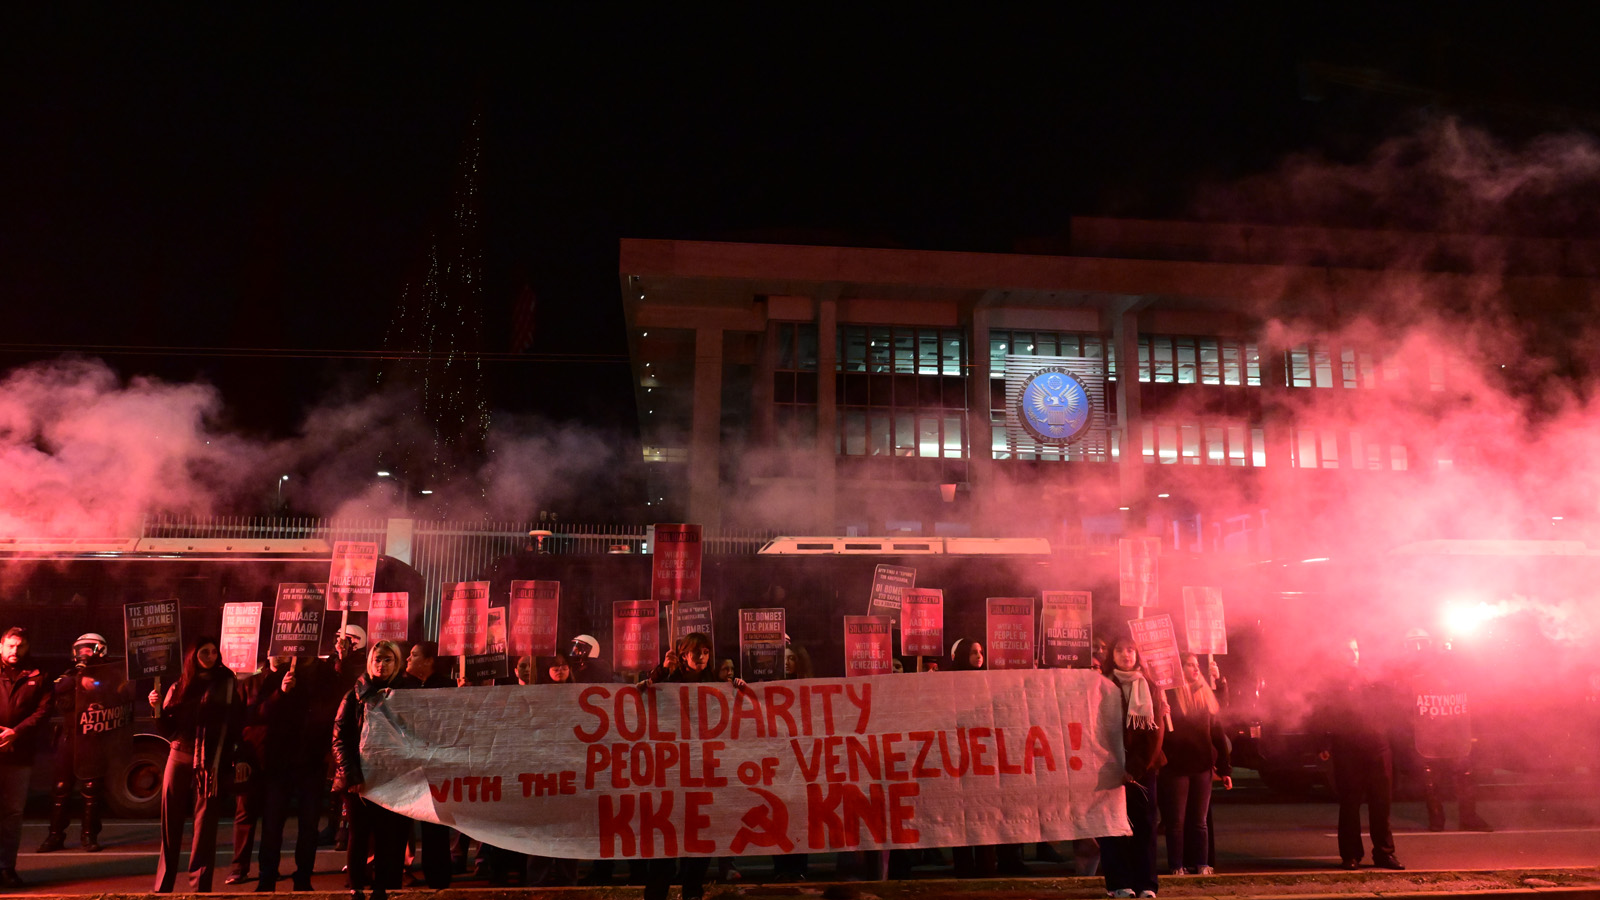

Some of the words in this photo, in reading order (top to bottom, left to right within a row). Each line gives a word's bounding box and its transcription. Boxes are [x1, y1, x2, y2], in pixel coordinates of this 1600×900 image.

[1017, 378, 1031, 407] UNITED
[1033, 366, 1060, 378] STATES
[1064, 368, 1073, 376] OF
[1077, 378, 1093, 408] AMERICA
[661, 560, 684, 568] PEOPLE
[332, 576, 371, 586] ΠΟΛΕΜΟΥΣ
[446, 590, 485, 599] SOLIDARITY
[129, 607, 141, 617] ΤΙΣ
[144, 603, 176, 615] ΒΟΜΒΕΣ
[992, 606, 1030, 615] SOLIDARITY
[132, 618, 144, 627] ΤΙΣ
[148, 614, 174, 625] ΡΙΧΝΕΙ
[279, 612, 319, 621] ΦΟΝΙΑΔΕΣ
[448, 615, 471, 624] PEOPLE
[744, 612, 753, 621] ΤΙΣ
[756, 612, 782, 620] ΒΟΜΒΕΣ
[746, 623, 756, 631] ΤΙΣ
[759, 622, 780, 631] ΡΙΧΝΕΙ
[924, 618, 935, 627] ΤΗΣ
[1134, 622, 1144, 632] ΤΙΣ
[277, 623, 292, 633] ΤΩΝ
[294, 623, 318, 633] ΛΑΩΝ
[444, 625, 484, 634] VENEZUELA!
[682, 624, 710, 634] ΒΟΜΒΕΣ
[850, 624, 887, 633] SOLIDARITY
[994, 631, 1018, 640] PEOPLE
[1020, 631, 1027, 640] OF
[1048, 628, 1088, 639] ΠΟΛΕΜΟΥΣ
[991, 641, 1030, 650] VENEZUELA!
[853, 650, 876, 658] PEOPLE
[877, 650, 885, 658] OF
[850, 660, 888, 669] VENEZUELA!
[1416, 692, 1467, 706] ΑΣΤΥΝΟΜΙΑ
[574, 682, 872, 743] SOLIDARITY
[1420, 704, 1467, 715] POLICE
[430, 776, 502, 803] WITH
[518, 771, 576, 798] THE
[585, 741, 728, 790] PEOPLE
[737, 757, 780, 786] OF
[598, 790, 716, 858] KKE
[807, 782, 920, 849] KNE
